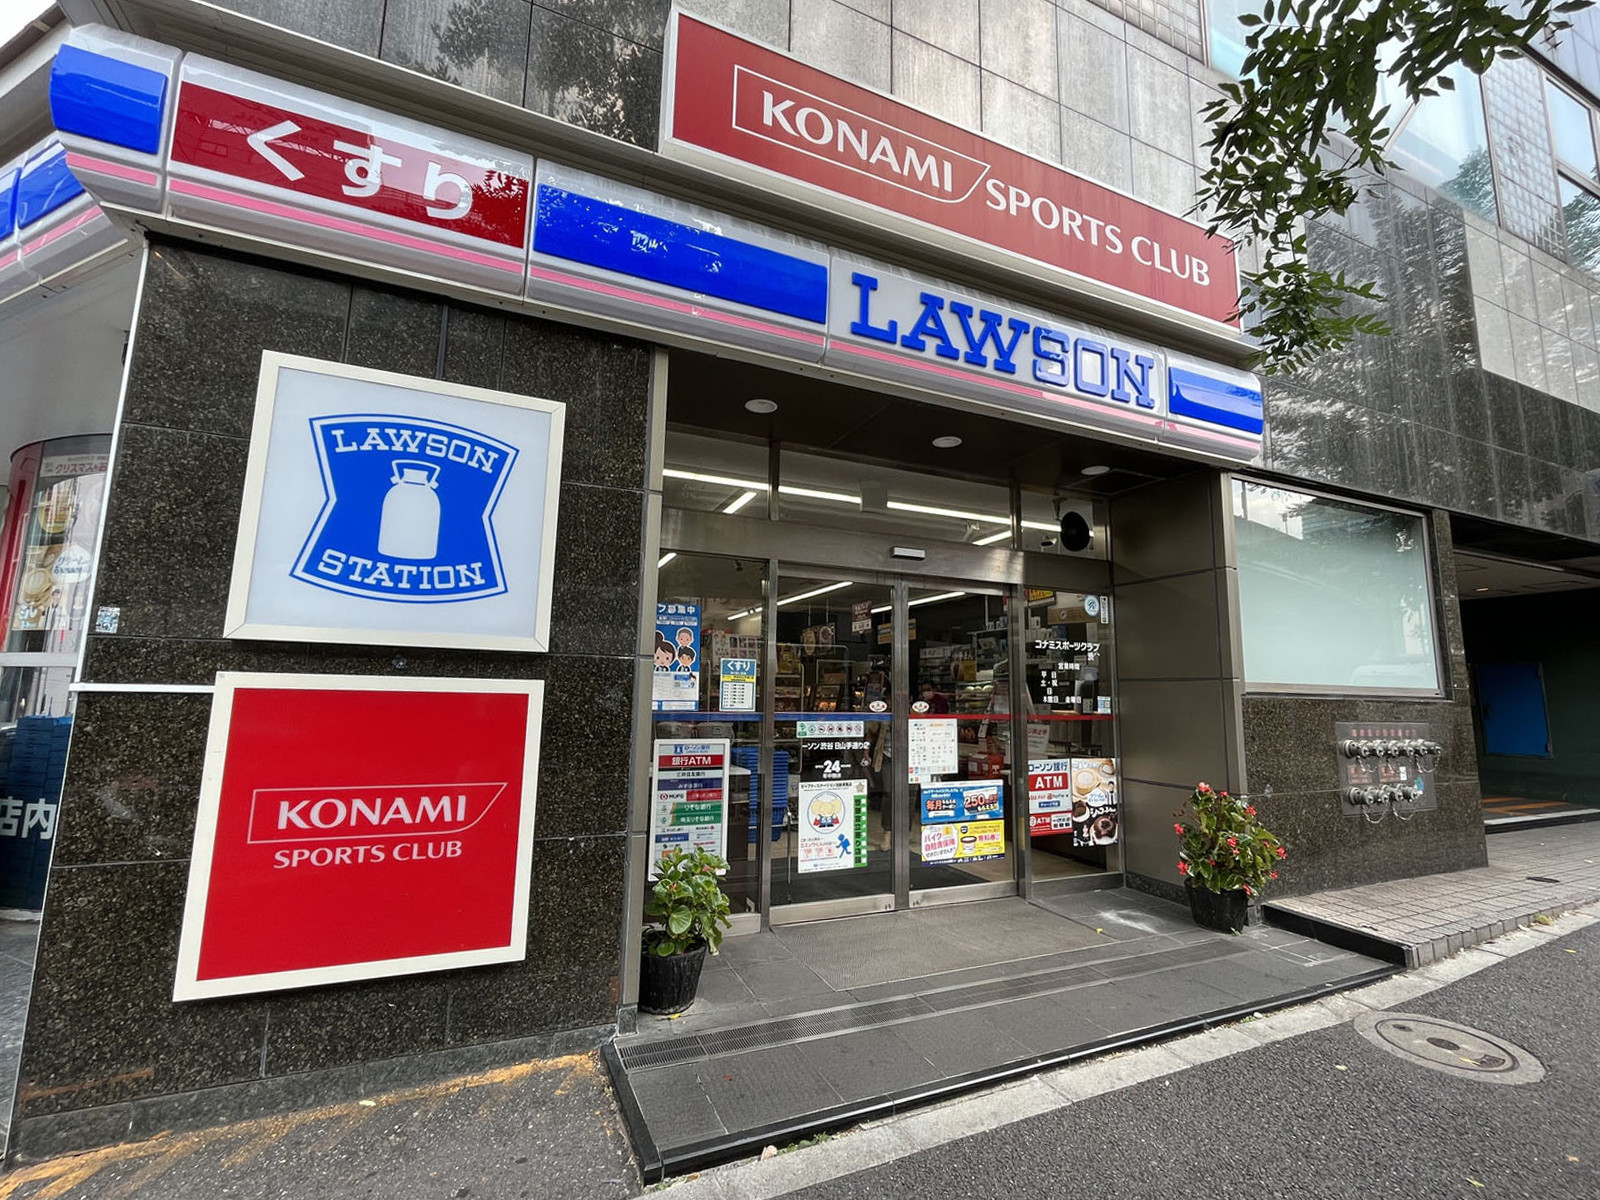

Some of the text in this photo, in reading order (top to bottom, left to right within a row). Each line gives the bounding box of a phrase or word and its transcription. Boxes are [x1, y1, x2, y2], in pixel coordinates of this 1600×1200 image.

[247, 119, 473, 220] くすり
[761, 90, 1210, 286] KONAMI SPORTS CLUB
[850, 272, 1156, 408] LAWSON
[331, 428, 499, 473] LAWSON
[317, 549, 485, 590] STATION
[727, 660, 750, 671] くすり
[672, 756, 712, 765] 銀行ATM
[823, 760, 841, 773] 24
[1035, 775, 1063, 789] ATM
[277, 795, 467, 830] KONAMI
[964, 794, 985, 808] 250
[273, 840, 462, 869] SPORTS CLUB
